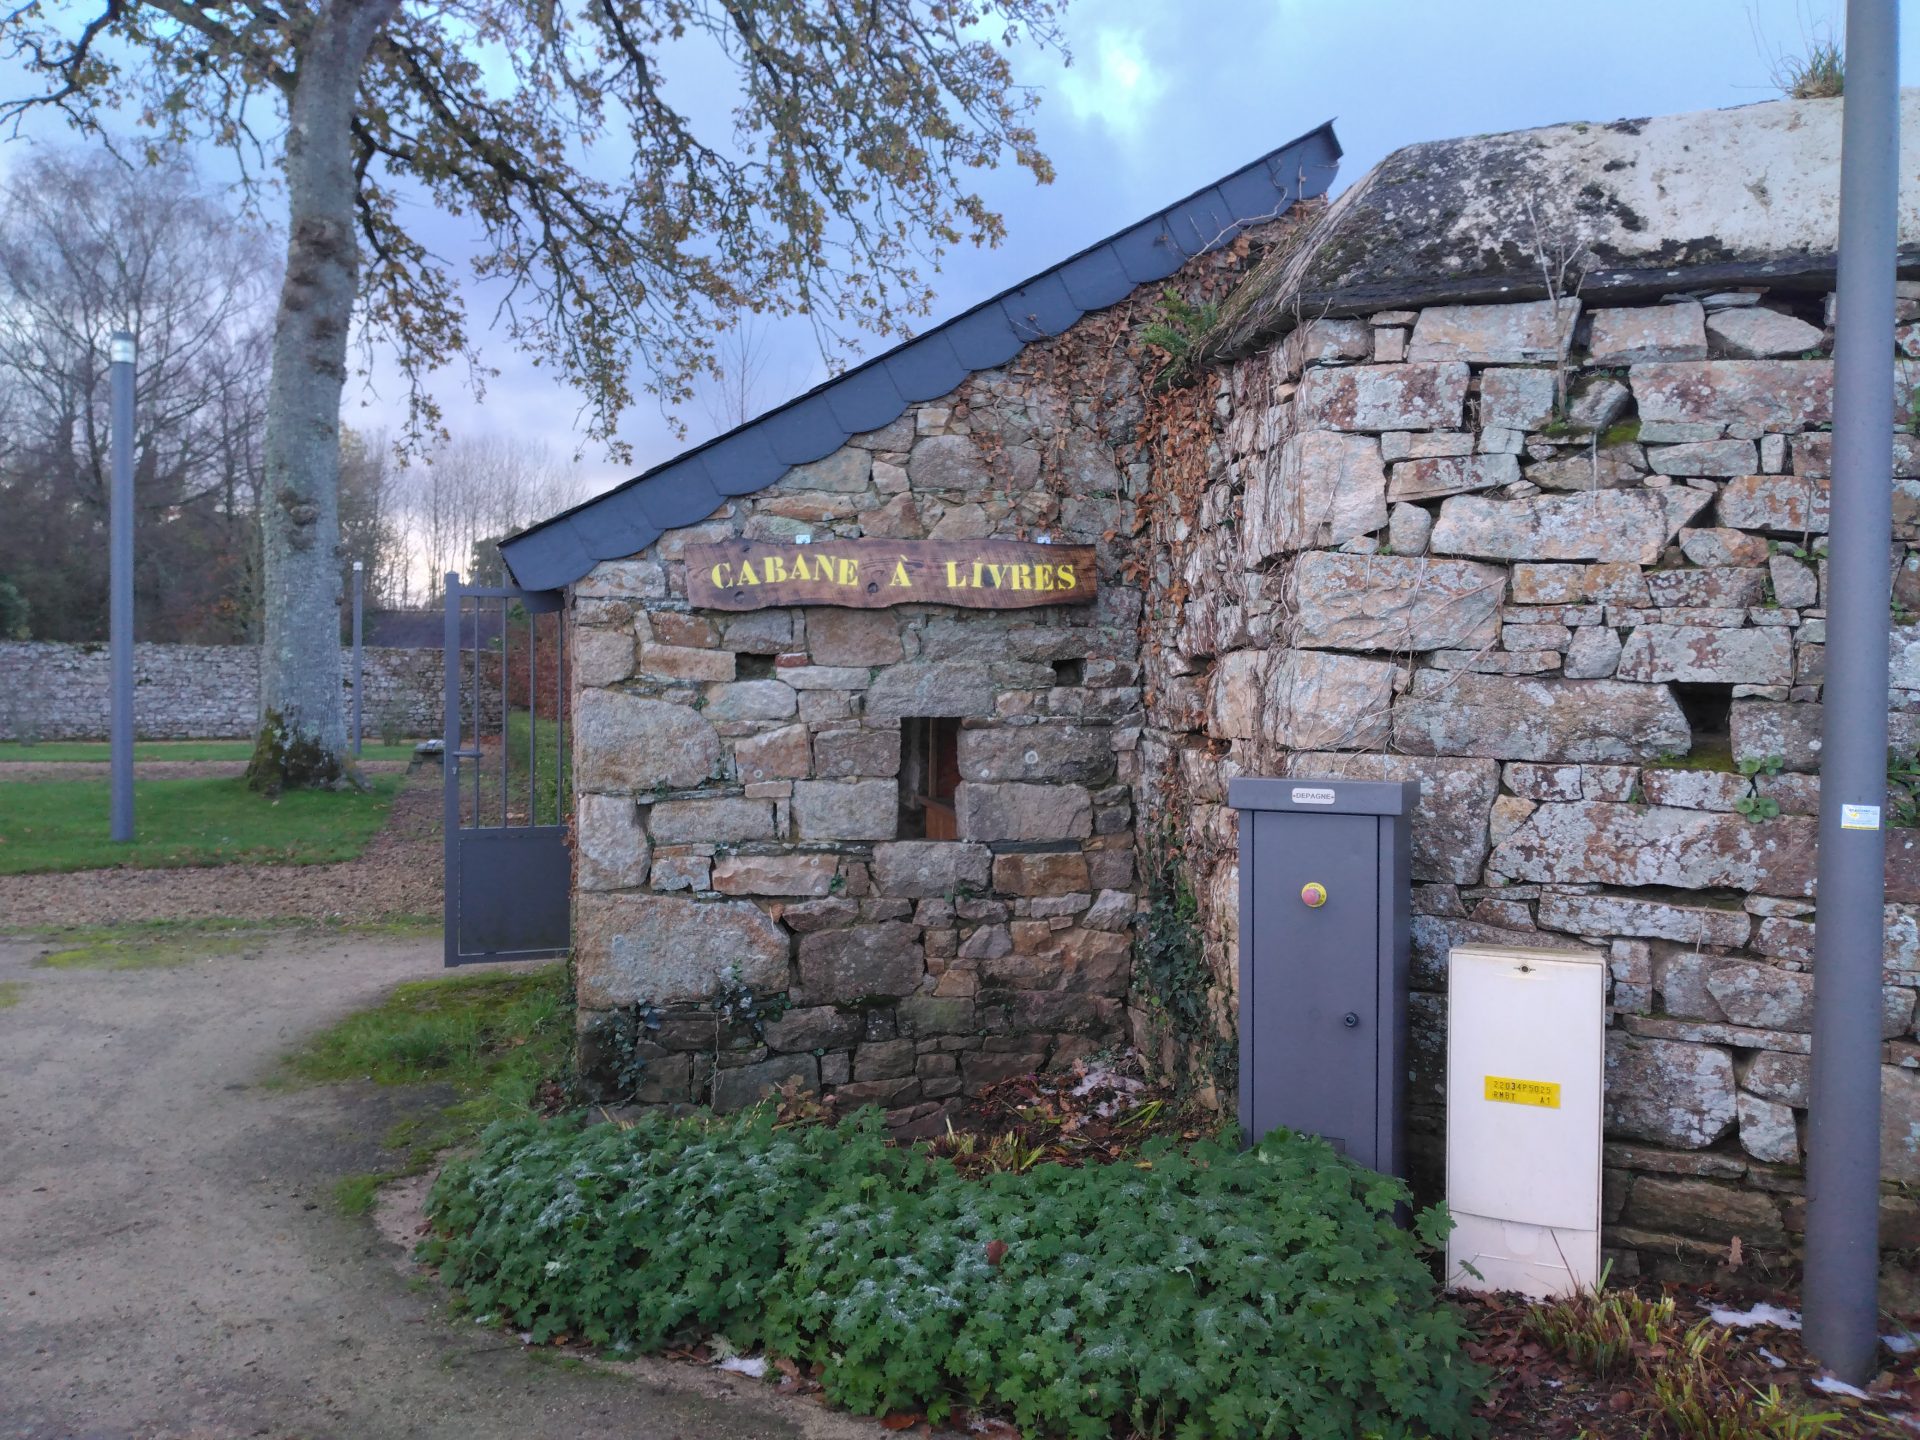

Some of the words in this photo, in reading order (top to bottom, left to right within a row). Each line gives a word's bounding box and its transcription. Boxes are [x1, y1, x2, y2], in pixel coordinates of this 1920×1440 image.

[711, 553, 859, 589] CABANE
[889, 554, 912, 587] À
[945, 560, 1076, 590] LIVRES
[1296, 792, 1331, 800] DEPAGNE
